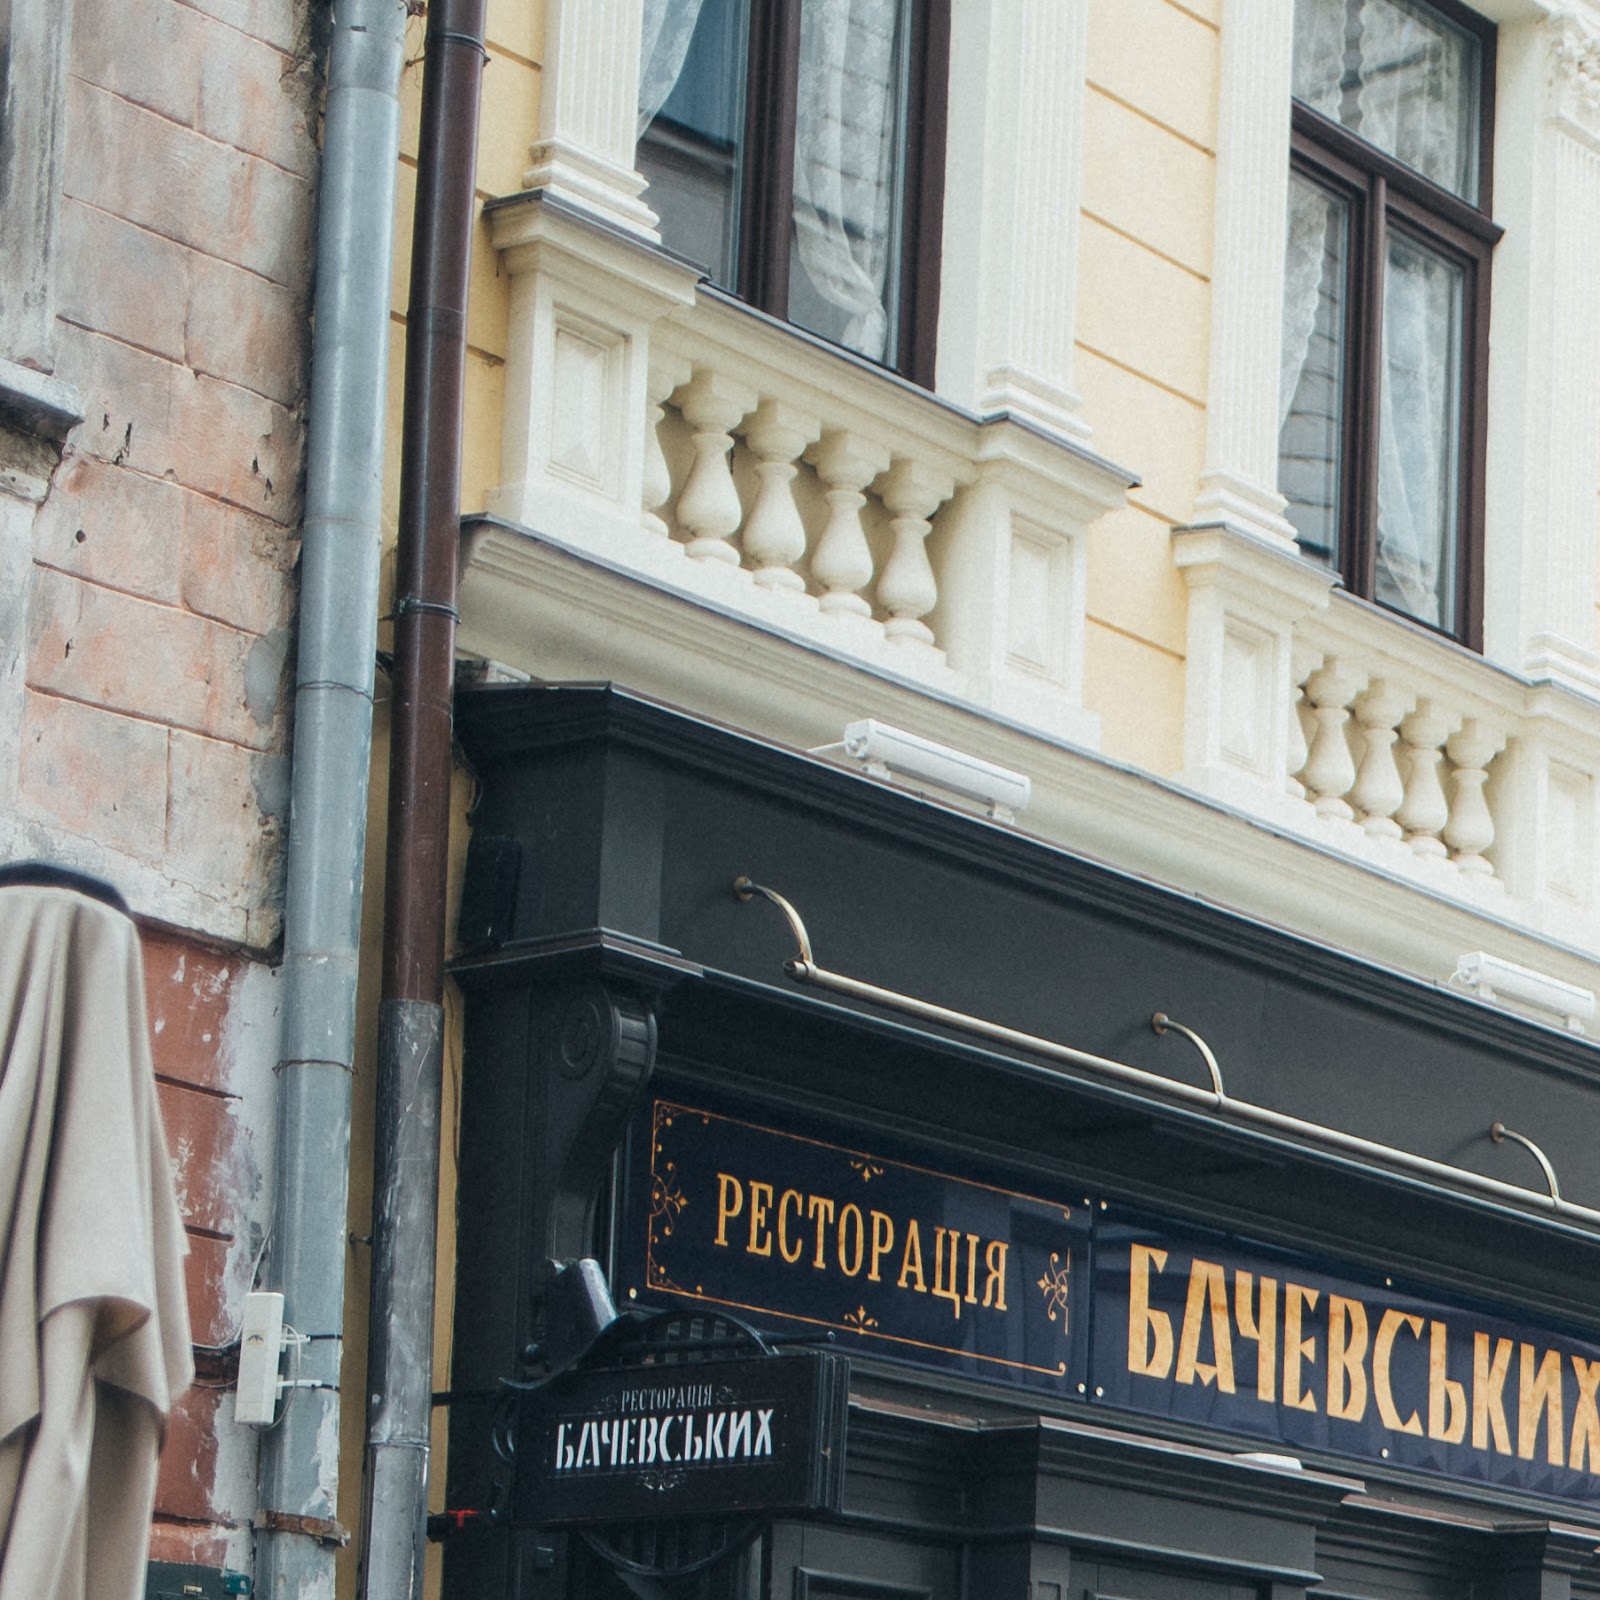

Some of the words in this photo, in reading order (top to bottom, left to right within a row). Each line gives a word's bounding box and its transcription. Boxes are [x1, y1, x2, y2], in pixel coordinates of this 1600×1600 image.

[714, 1172, 1009, 1320] РЕСТОРАЦІЯ
[620, 1384, 713, 1412] РЕСТОРАЦІЯ
[556, 1408, 774, 1469] БАЧЕВСЬКИХ
